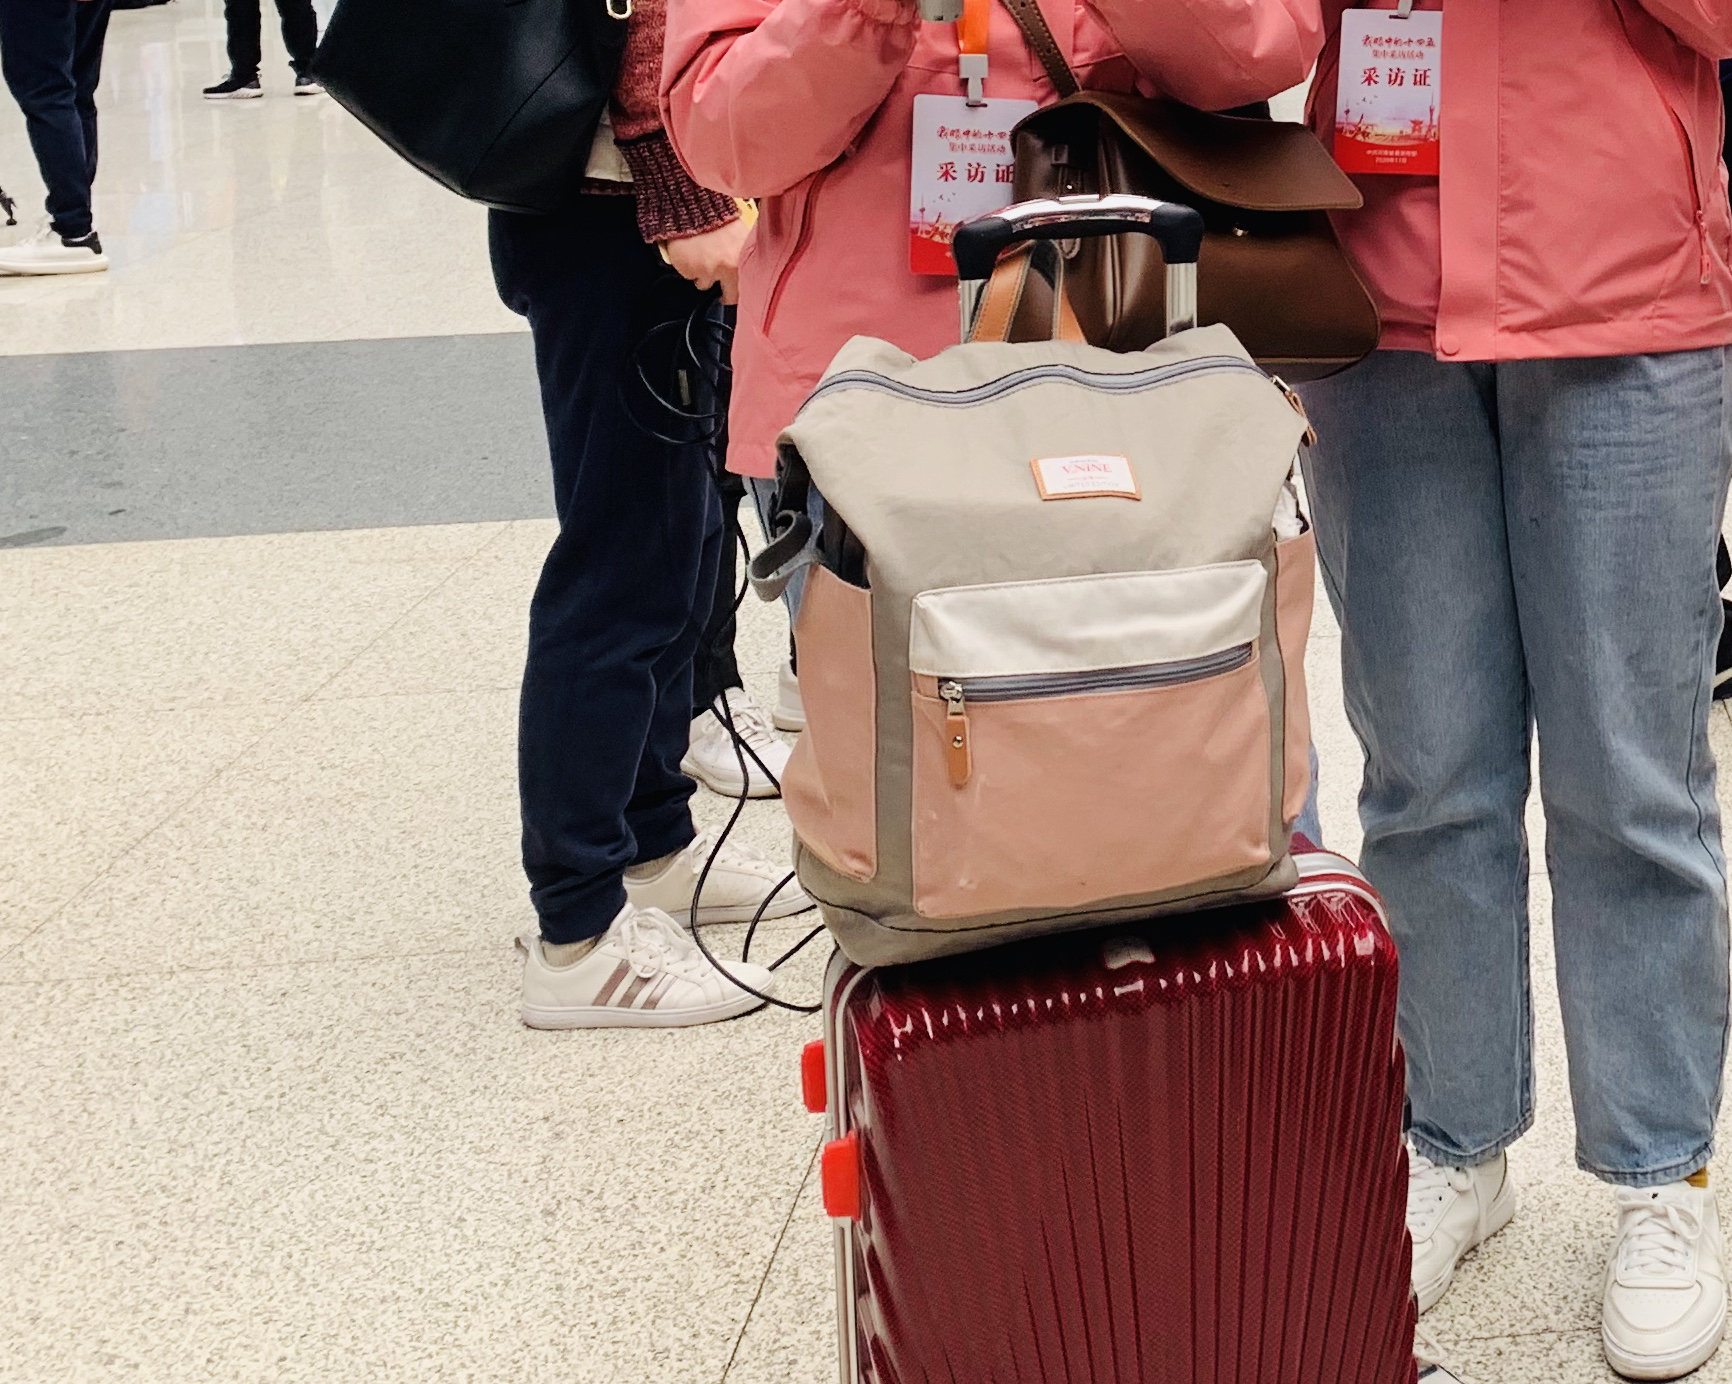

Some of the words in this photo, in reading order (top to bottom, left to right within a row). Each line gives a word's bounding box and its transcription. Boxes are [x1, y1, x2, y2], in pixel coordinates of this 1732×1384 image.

[1361, 67, 1432, 87] 采访证
[936, 162, 1014, 183] 采访证
